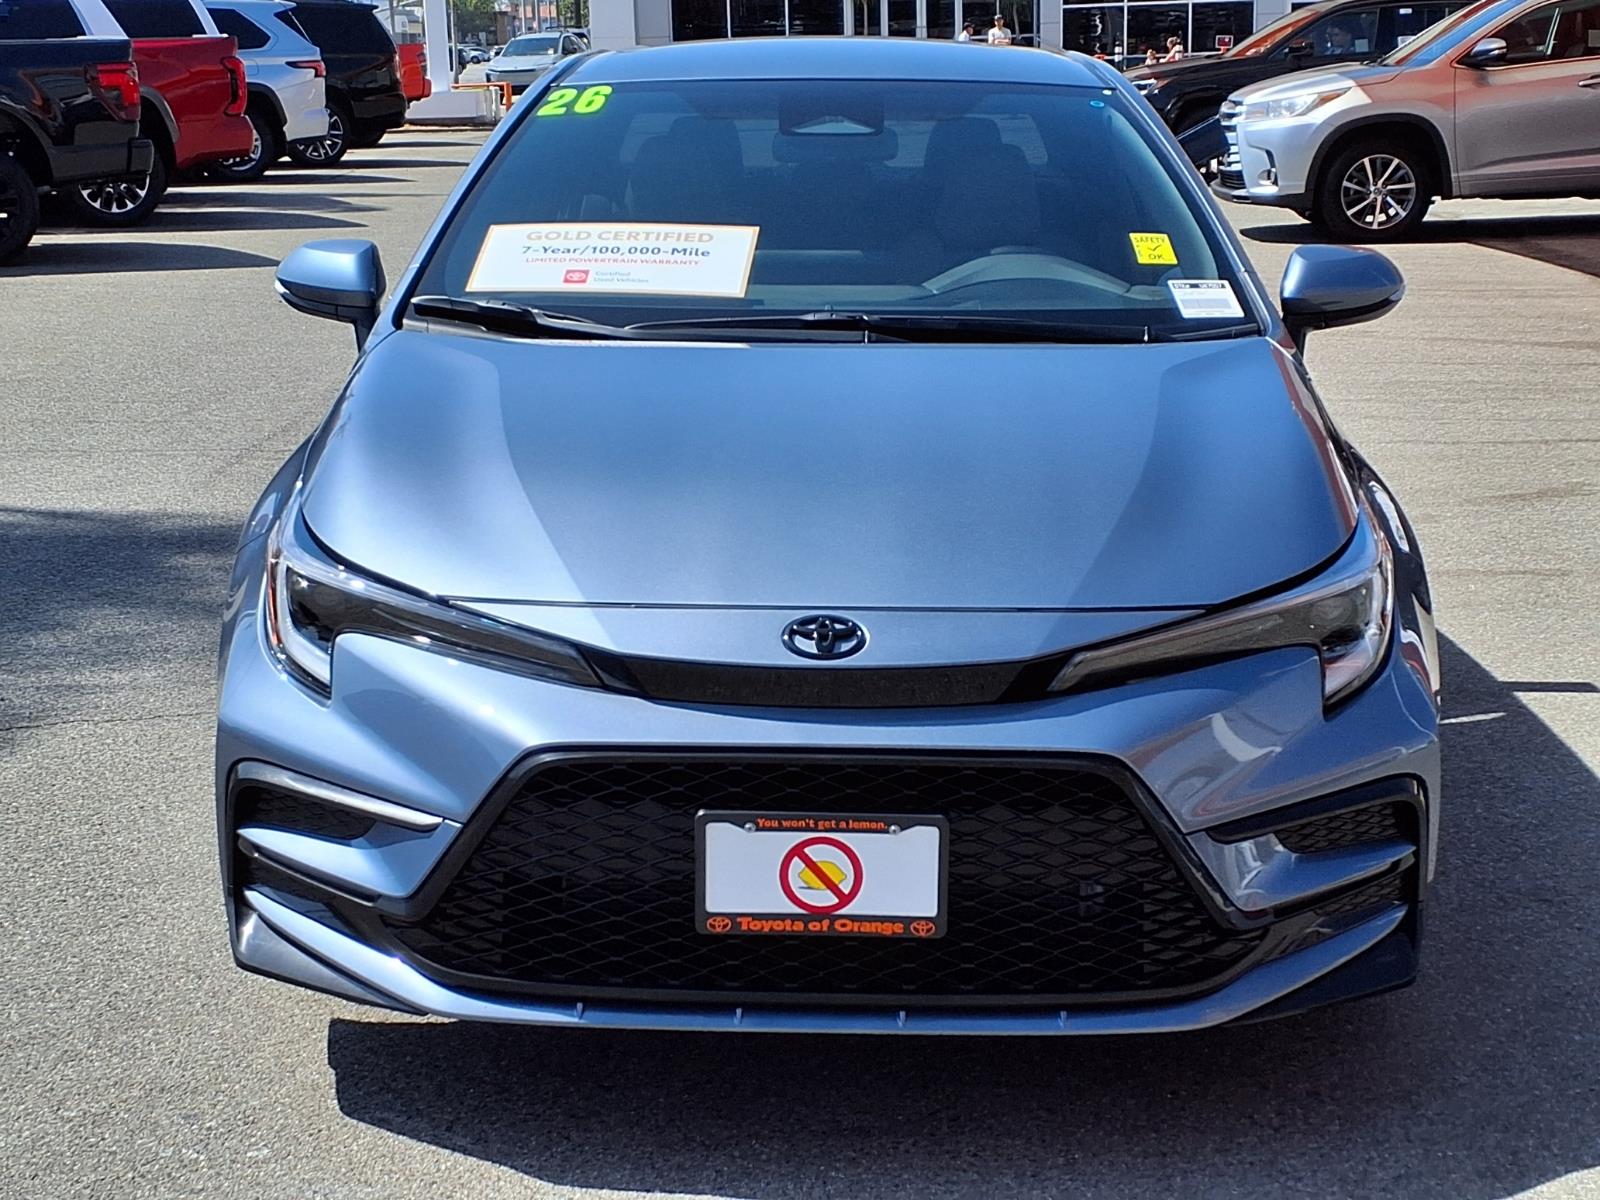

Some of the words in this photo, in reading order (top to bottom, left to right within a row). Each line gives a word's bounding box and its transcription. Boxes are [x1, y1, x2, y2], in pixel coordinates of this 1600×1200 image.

[536, 85, 613, 116] 26
[526, 230, 592, 241] GOLD
[597, 231, 714, 243] CERTIFIED
[1133, 235, 1166, 244] SAFETY
[522, 244, 711, 257] 7-Year/100,000-Mile
[640, 258, 701, 266] WARRANTY
[756, 818, 778, 827] You
[781, 818, 815, 828] won't
[817, 819, 836, 830] get
[838, 821, 847, 829] a
[849, 819, 888, 830] lemon.
[737, 916, 804, 933] Toyota
[808, 918, 831, 932] of
[834, 918, 905, 936] Orange
